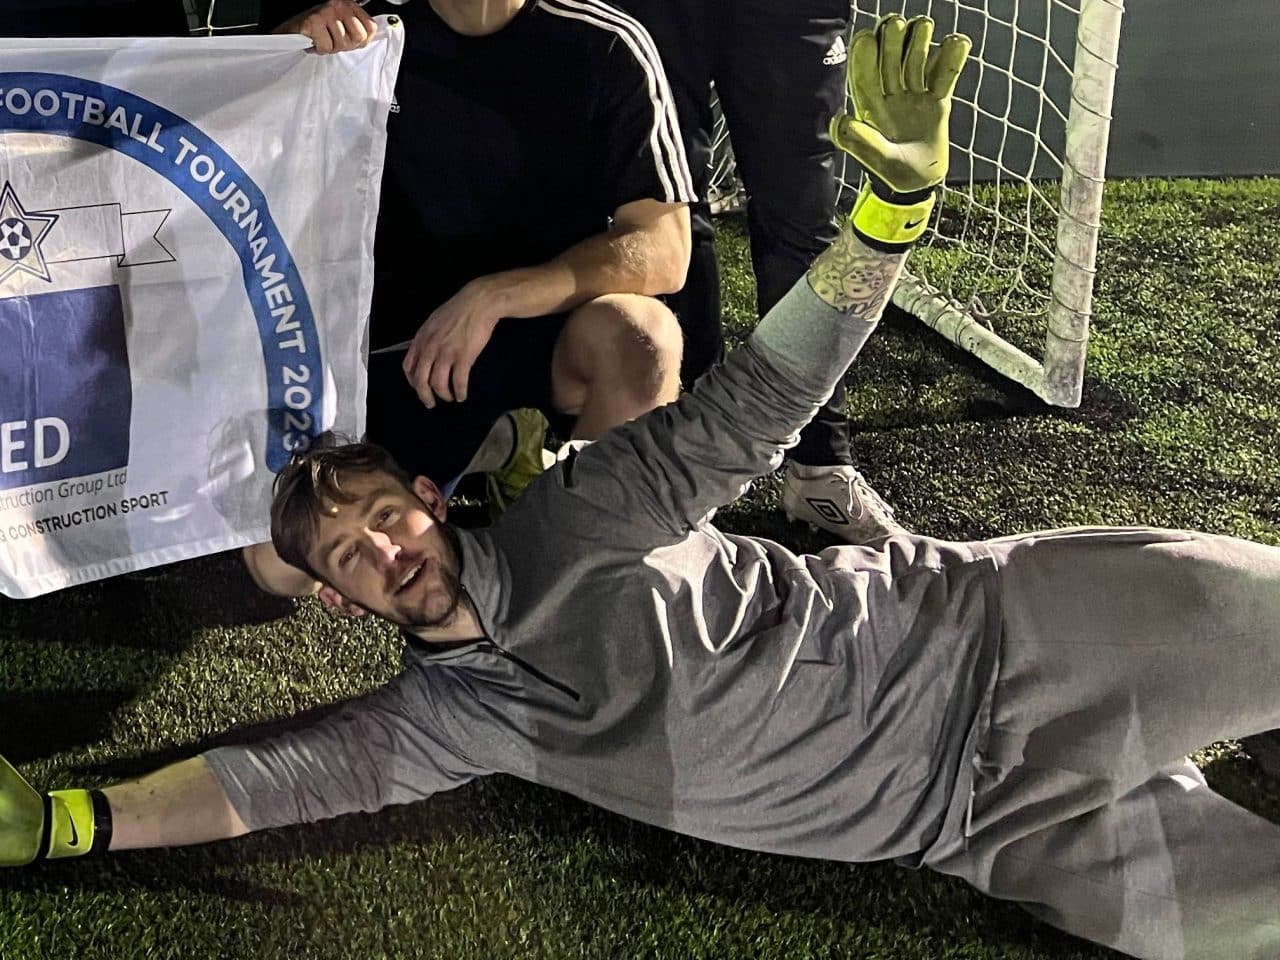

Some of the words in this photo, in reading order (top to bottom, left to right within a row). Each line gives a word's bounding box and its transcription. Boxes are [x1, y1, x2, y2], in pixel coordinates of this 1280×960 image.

[172, 136, 306, 353] TOURNAMENT
[57, 477, 104, 499] Group
[108, 470, 128, 488] Ltd
[8, 503, 117, 541] CONSTRUCTION
[121, 490, 169, 514] SPORT
